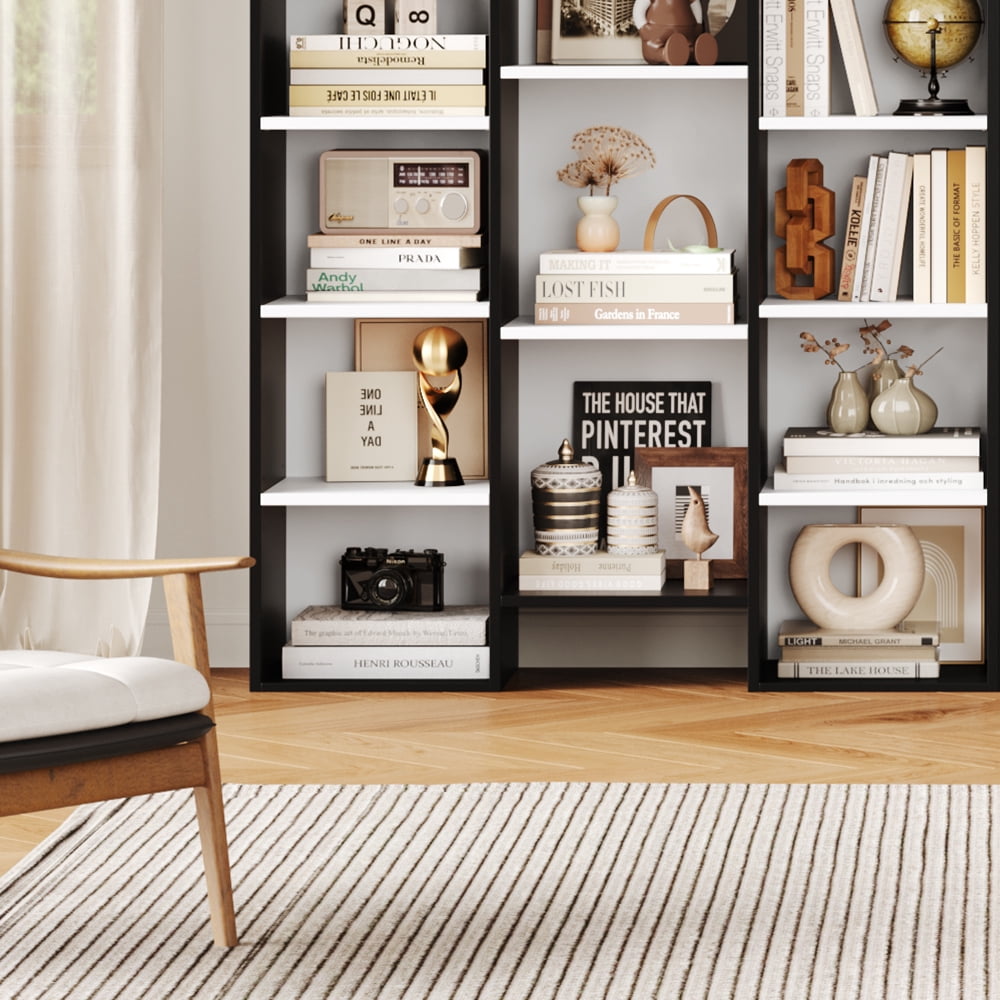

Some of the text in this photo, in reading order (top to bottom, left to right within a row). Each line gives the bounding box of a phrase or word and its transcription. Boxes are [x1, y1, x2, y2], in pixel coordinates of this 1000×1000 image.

[356, 4, 376, 27] Q
[409, 10, 429, 23] 8
[766, 14, 783, 52] Erwitt
[339, 37, 446, 50] NOGUCHI
[357, 56, 425, 65] Remodelista
[766, 56, 783, 100] Snaps
[327, 90, 436, 102] IL ÉTAIT UNE FOIS LE CAFÉ
[953, 217, 960, 227] OF
[971, 183, 980, 275] KELLY HOPPEN STYLE
[318, 272, 357, 284] Andy
[542, 281, 625, 298] LOST FISH
[594, 309, 680, 319] Gardens in France
[582, 392, 706, 414] THE HOUSE THAT
[582, 420, 706, 449] PINTEREST
[354, 660, 453, 668] HENRI ROUSSEAU
[807, 667, 909, 675] THE LAKE HOUSE
